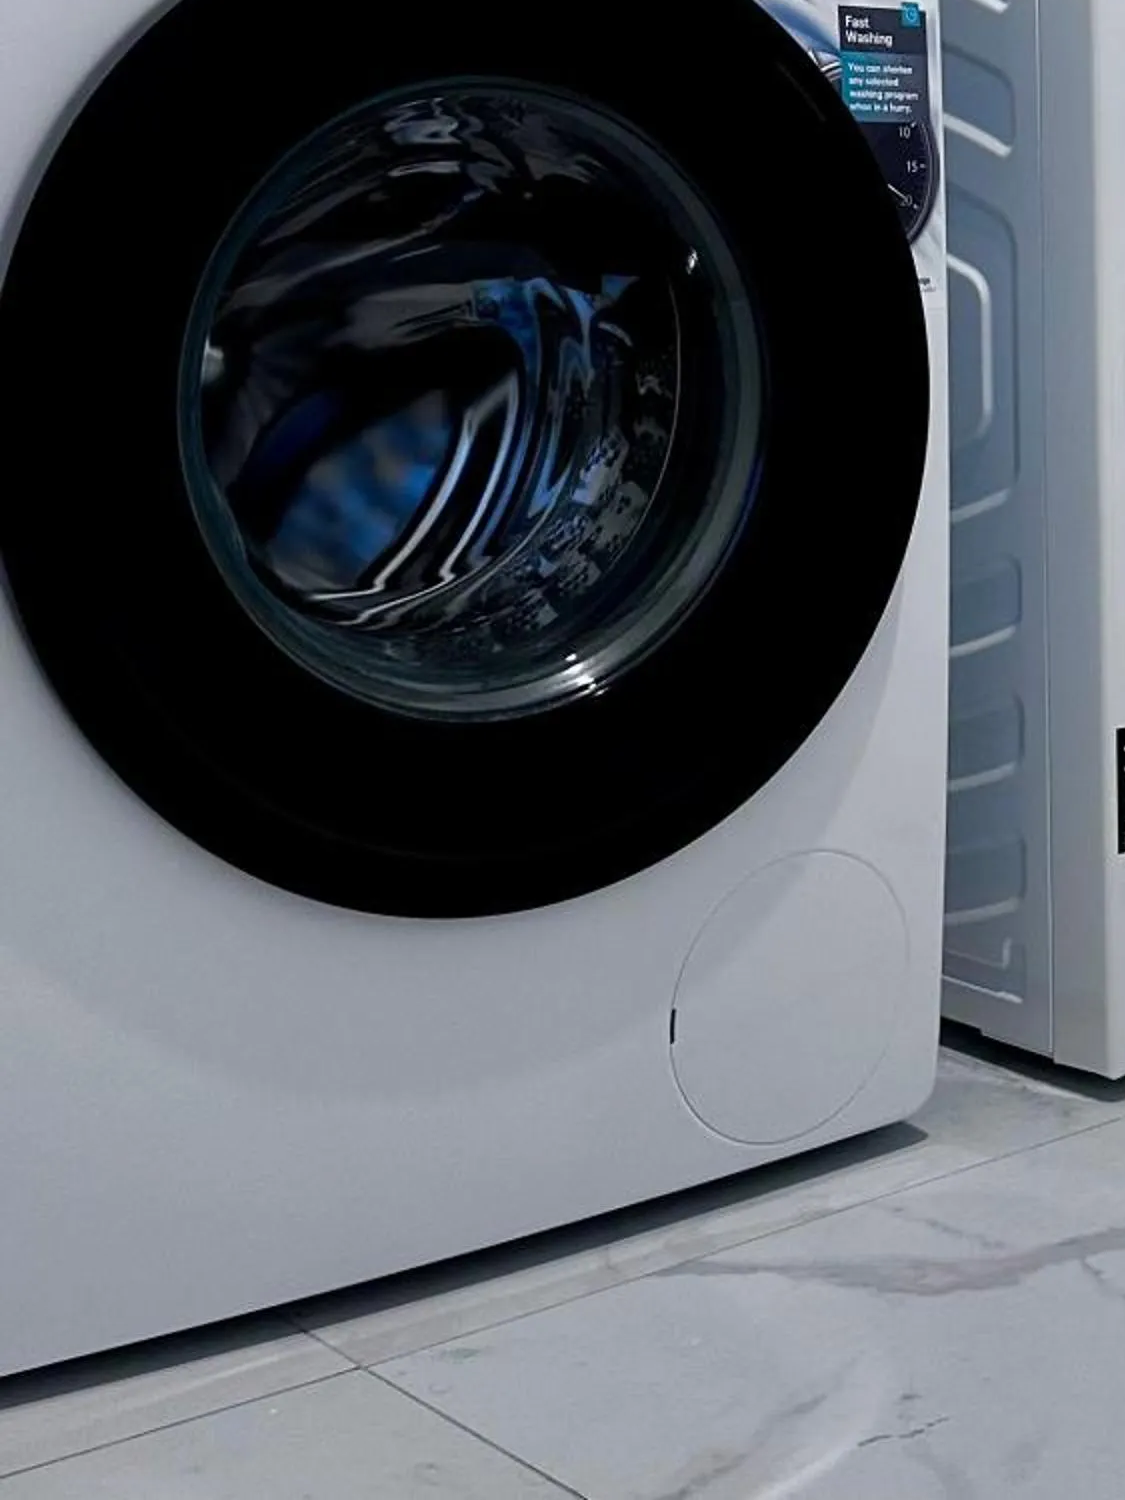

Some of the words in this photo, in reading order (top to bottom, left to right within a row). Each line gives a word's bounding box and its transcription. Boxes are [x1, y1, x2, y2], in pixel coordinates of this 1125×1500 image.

[845, 15, 870, 29] Fast
[845, 30, 893, 48] Washing
[848, 63, 864, 73] You
[866, 65, 880, 73] can
[849, 90, 883, 100] washing
[884, 91, 918, 101] program
[874, 102, 880, 110] in
[899, 126, 910, 139] 10
[906, 160, 918, 173] 15
